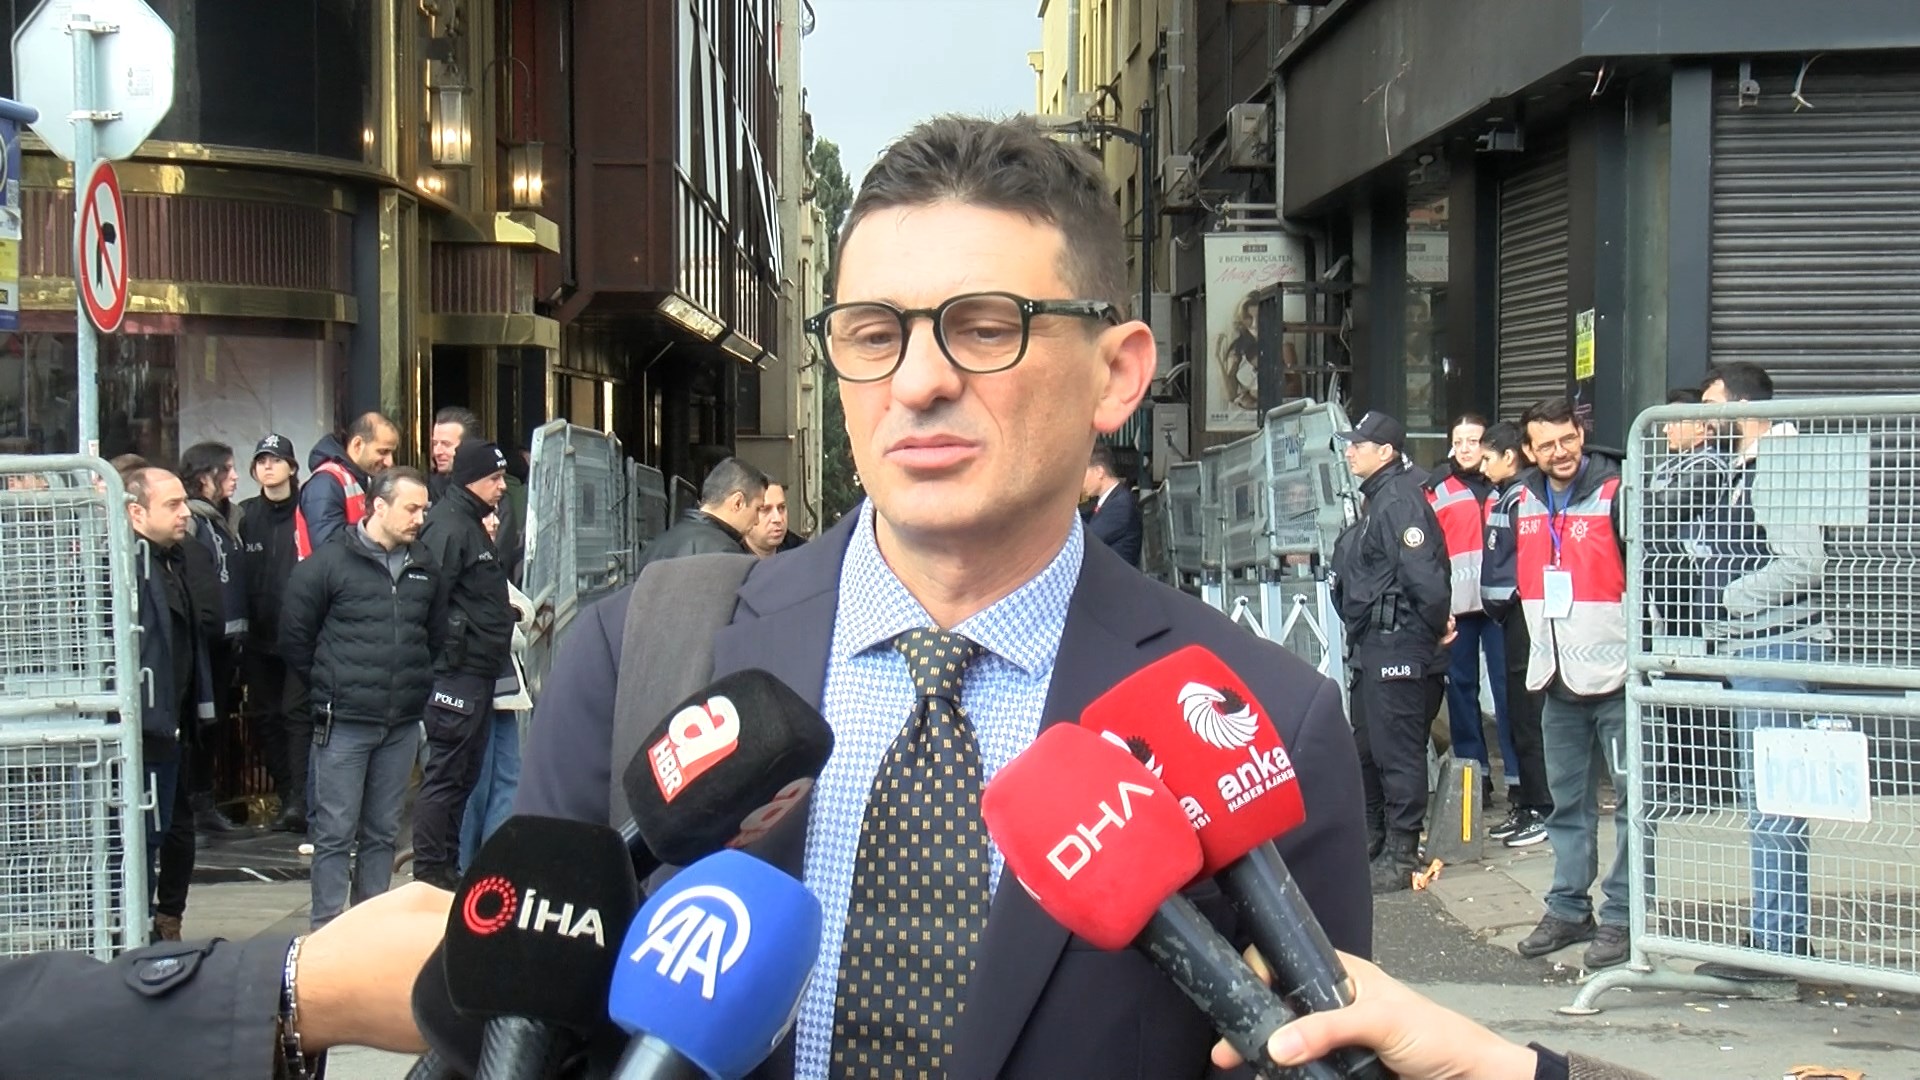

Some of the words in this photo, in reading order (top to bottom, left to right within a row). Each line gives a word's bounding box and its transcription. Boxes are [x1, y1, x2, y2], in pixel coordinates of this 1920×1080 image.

[652, 738, 684, 796] HBR
[1217, 744, 1292, 801] anka
[1227, 784, 1265, 813] HABER
[1046, 781, 1155, 880] DHA
[517, 888, 606, 947] İHA
[630, 905, 727, 1000] AA
